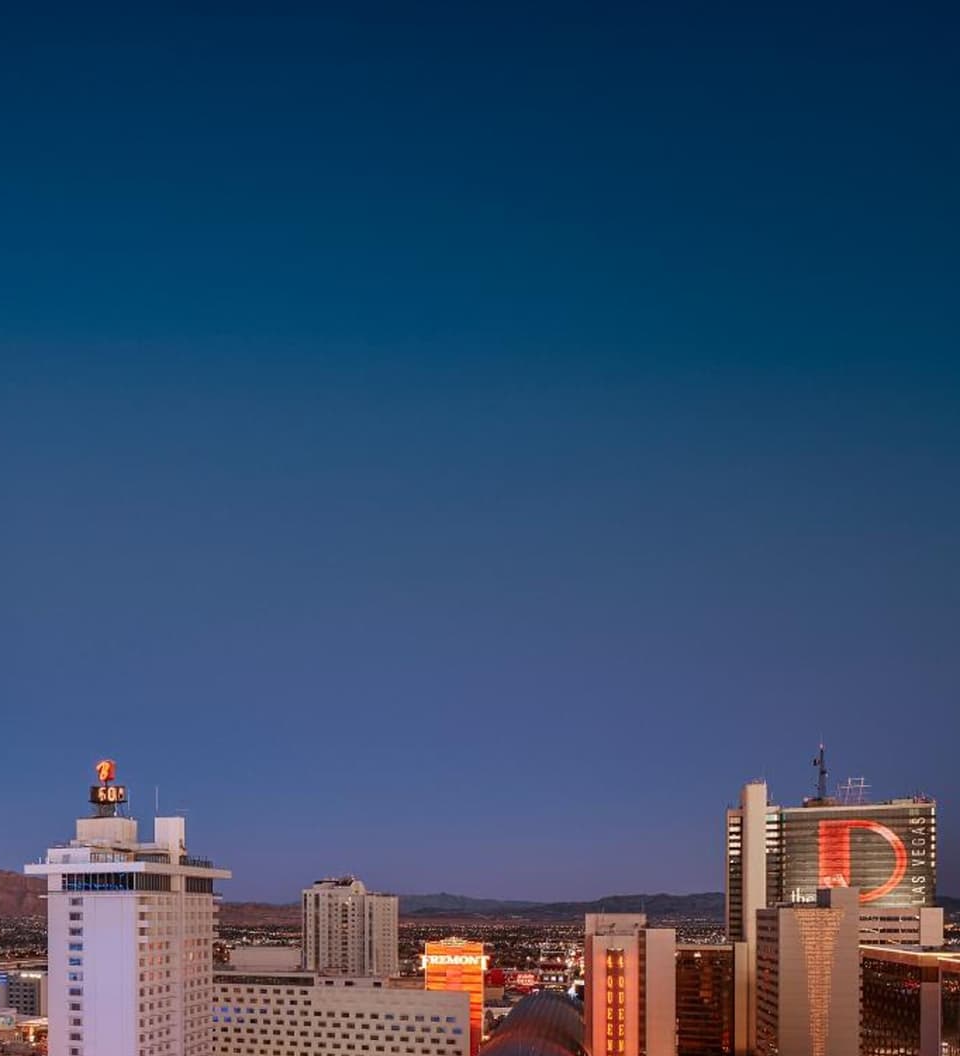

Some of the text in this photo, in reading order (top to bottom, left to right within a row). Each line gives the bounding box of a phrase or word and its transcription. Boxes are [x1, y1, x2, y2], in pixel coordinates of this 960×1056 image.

[791, 820, 907, 904] the D
[911, 817, 926, 904] LAS VEGAS
[419, 954, 490, 970] FREMONT
